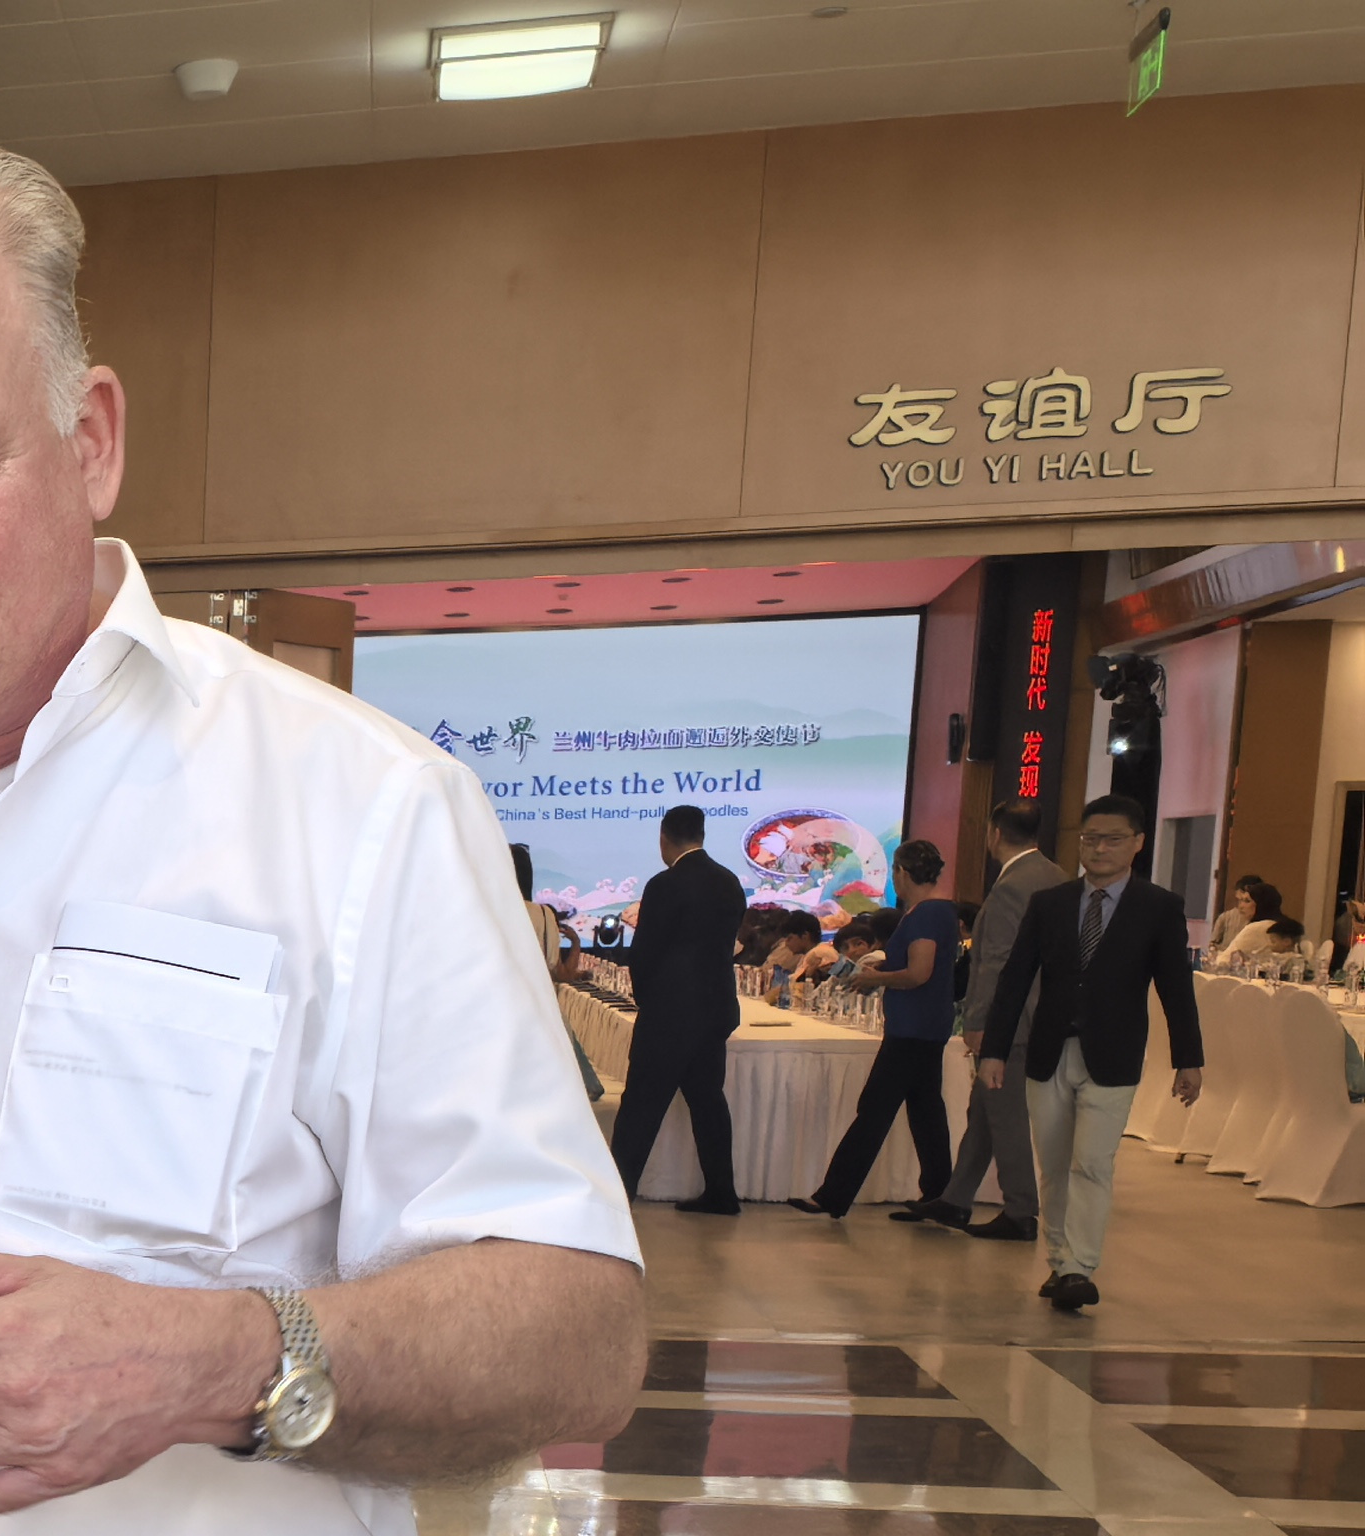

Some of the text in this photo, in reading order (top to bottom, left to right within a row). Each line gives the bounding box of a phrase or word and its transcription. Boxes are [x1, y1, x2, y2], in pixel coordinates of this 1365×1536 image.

[848, 366, 1232, 447] 友谊厅
[881, 448, 1154, 489] YOU YI HALL
[1019, 609, 1054, 797] 新时代 发现
[531, 774, 613, 798] Meets
[621, 772, 665, 796] the
[673, 768, 762, 794] World
[554, 807, 587, 820] Best
[591, 806, 667, 821] Hand-pull
[699, 804, 749, 818] oodles
